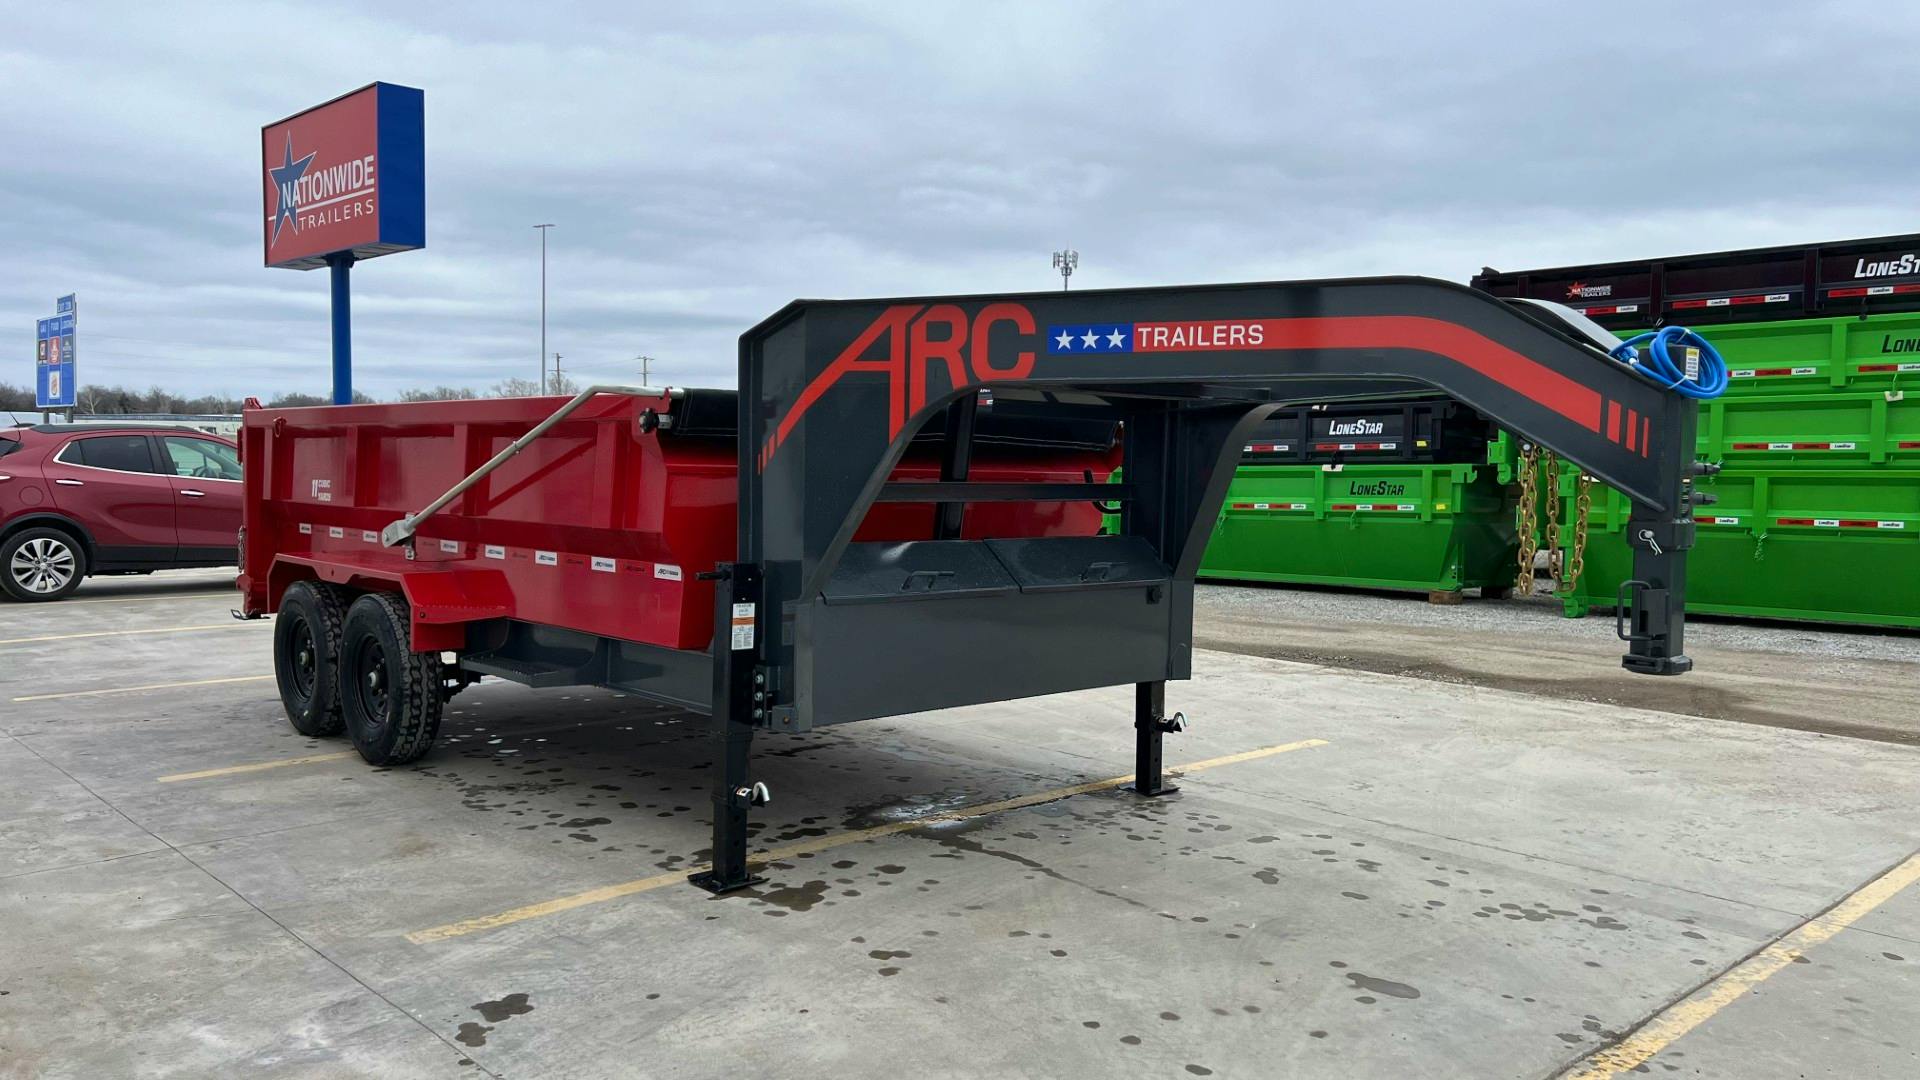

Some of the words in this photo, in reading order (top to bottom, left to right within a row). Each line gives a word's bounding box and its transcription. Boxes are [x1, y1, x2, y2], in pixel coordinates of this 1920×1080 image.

[282, 155, 374, 209] NATIONWIDE
[299, 199, 374, 231] TRAILERS
[1854, 254, 1920, 278] LONEST
[1138, 324, 1264, 347] TRAILERS
[757, 302, 1036, 475] ARC
